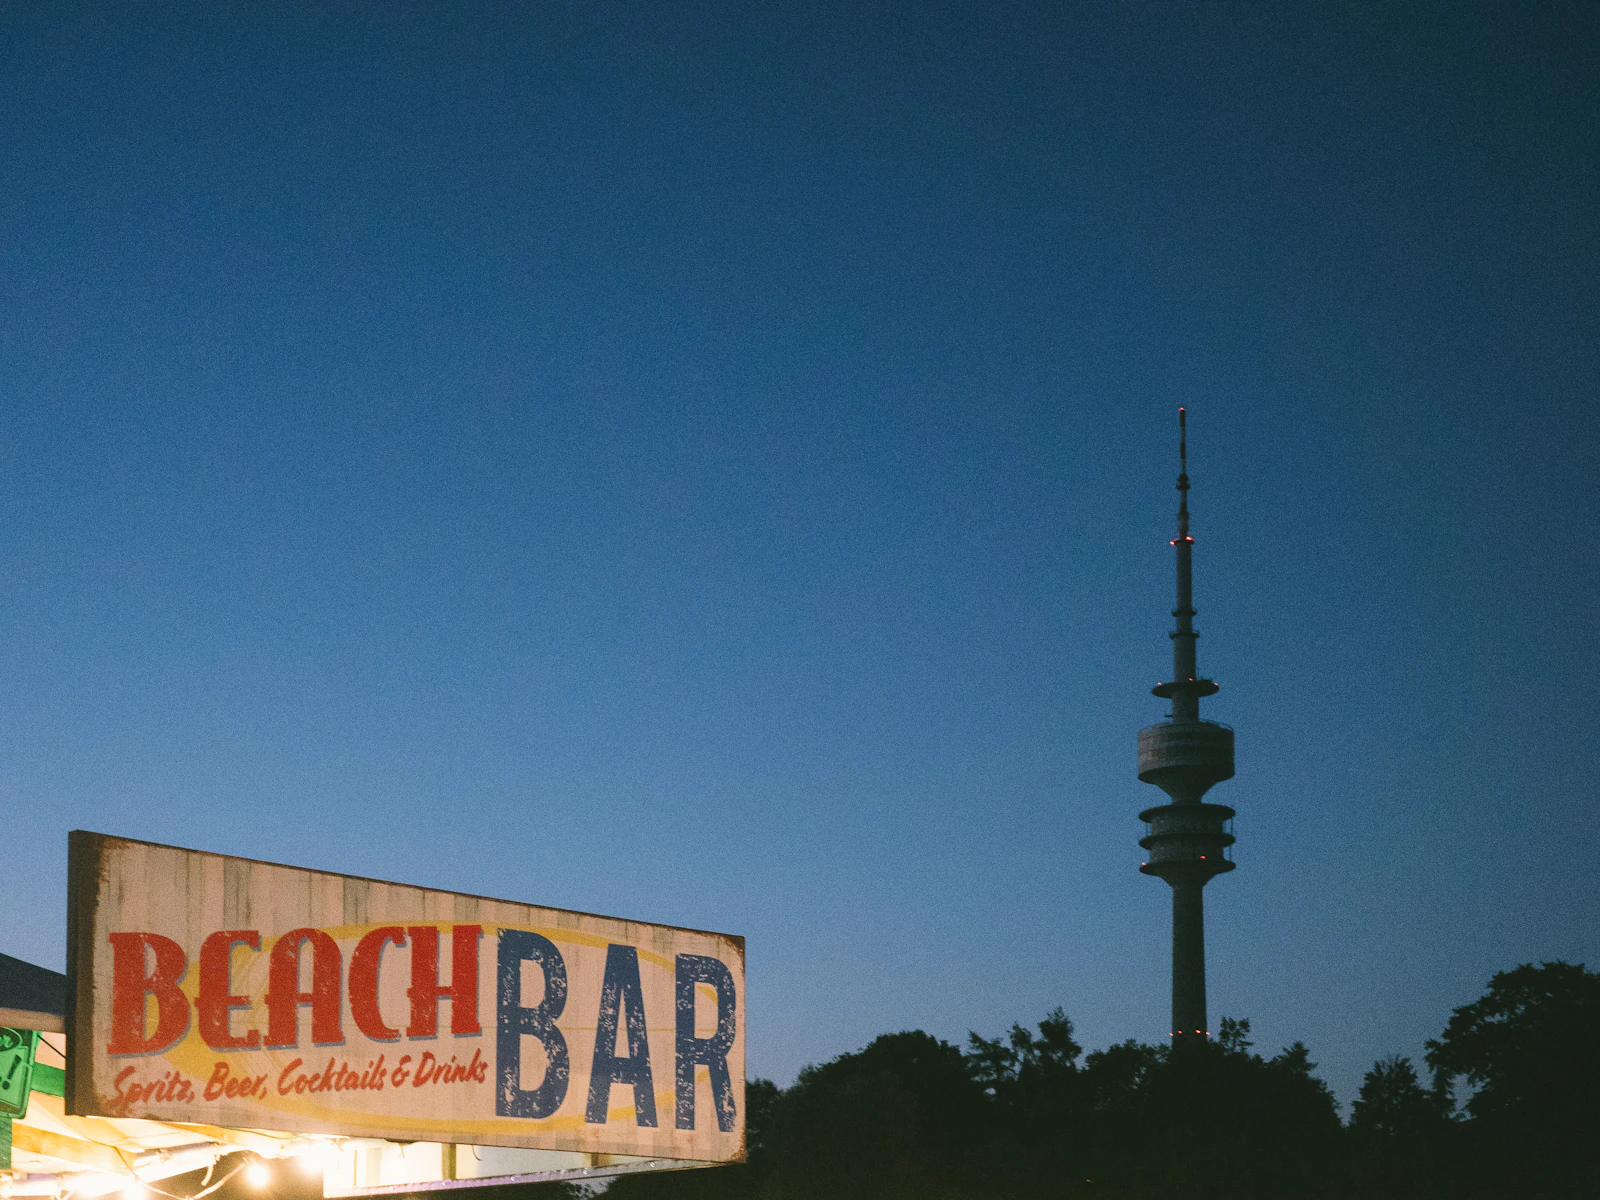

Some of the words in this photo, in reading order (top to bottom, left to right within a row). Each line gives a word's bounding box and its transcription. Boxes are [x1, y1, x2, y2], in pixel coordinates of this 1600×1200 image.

[107, 924, 485, 1058] BEACH
[495, 927, 738, 1133] BAR
[108, 1065, 196, 1113] Spritz,
[204, 1061, 267, 1103] Beer,
[278, 1054, 387, 1097] Cocktails
[391, 1057, 412, 1085] &
[413, 1048, 488, 1087] Drinks
